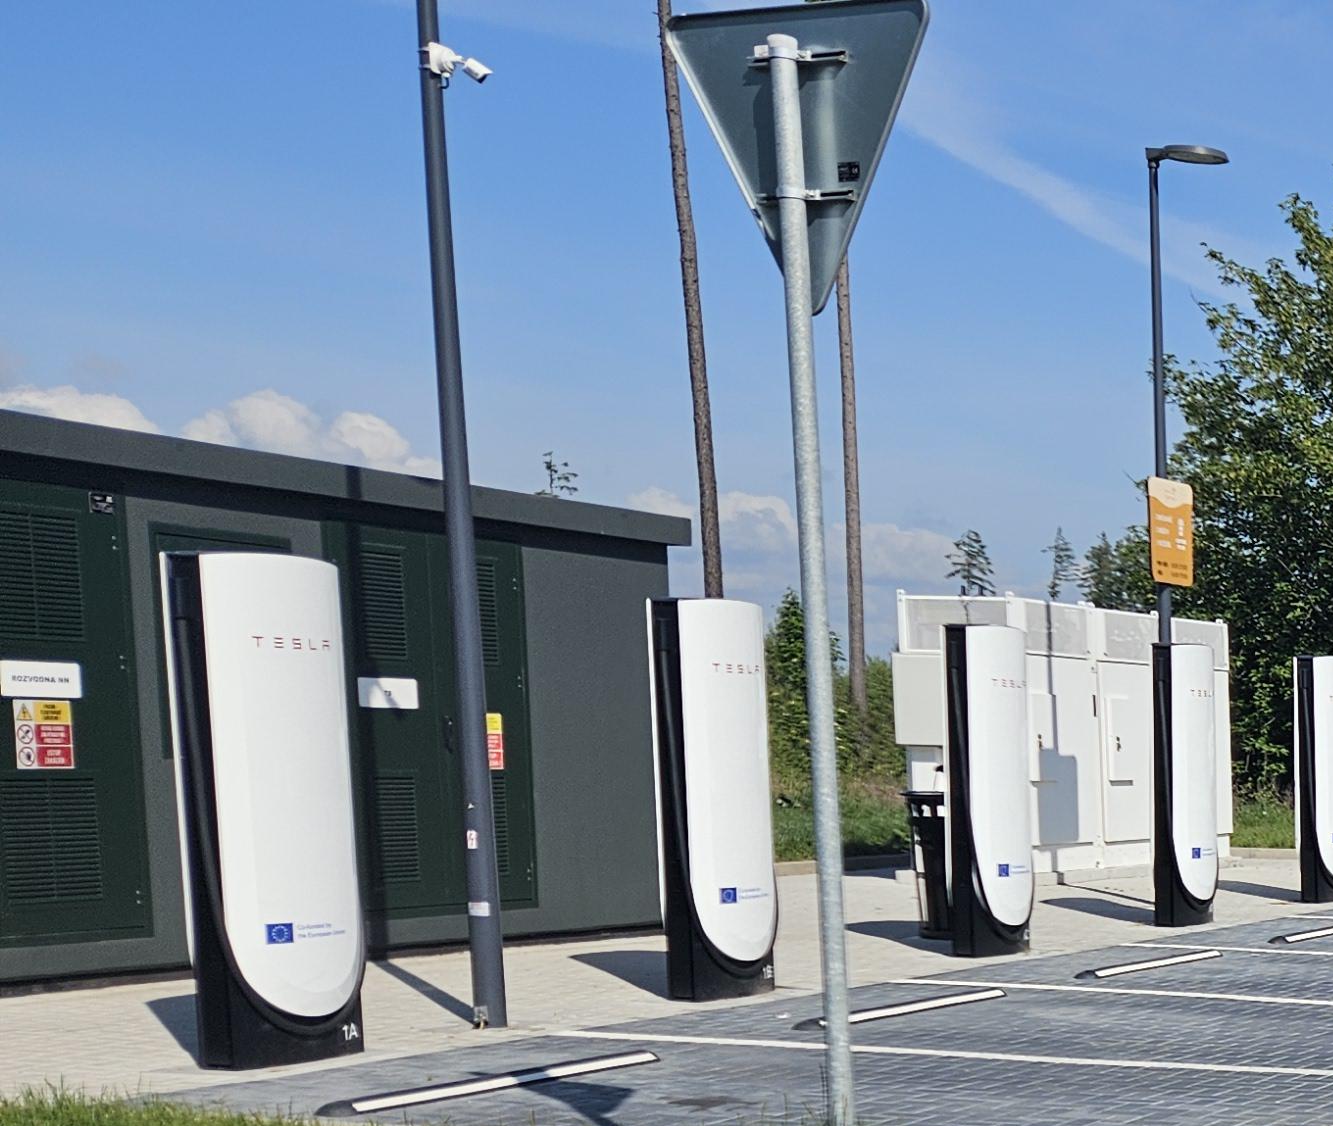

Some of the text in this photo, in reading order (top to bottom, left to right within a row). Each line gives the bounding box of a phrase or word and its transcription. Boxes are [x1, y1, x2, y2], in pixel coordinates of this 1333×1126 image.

[252, 635, 331, 651] TESLA
[712, 663, 760, 674] TESLA
[342, 1022, 359, 1041] 1A
